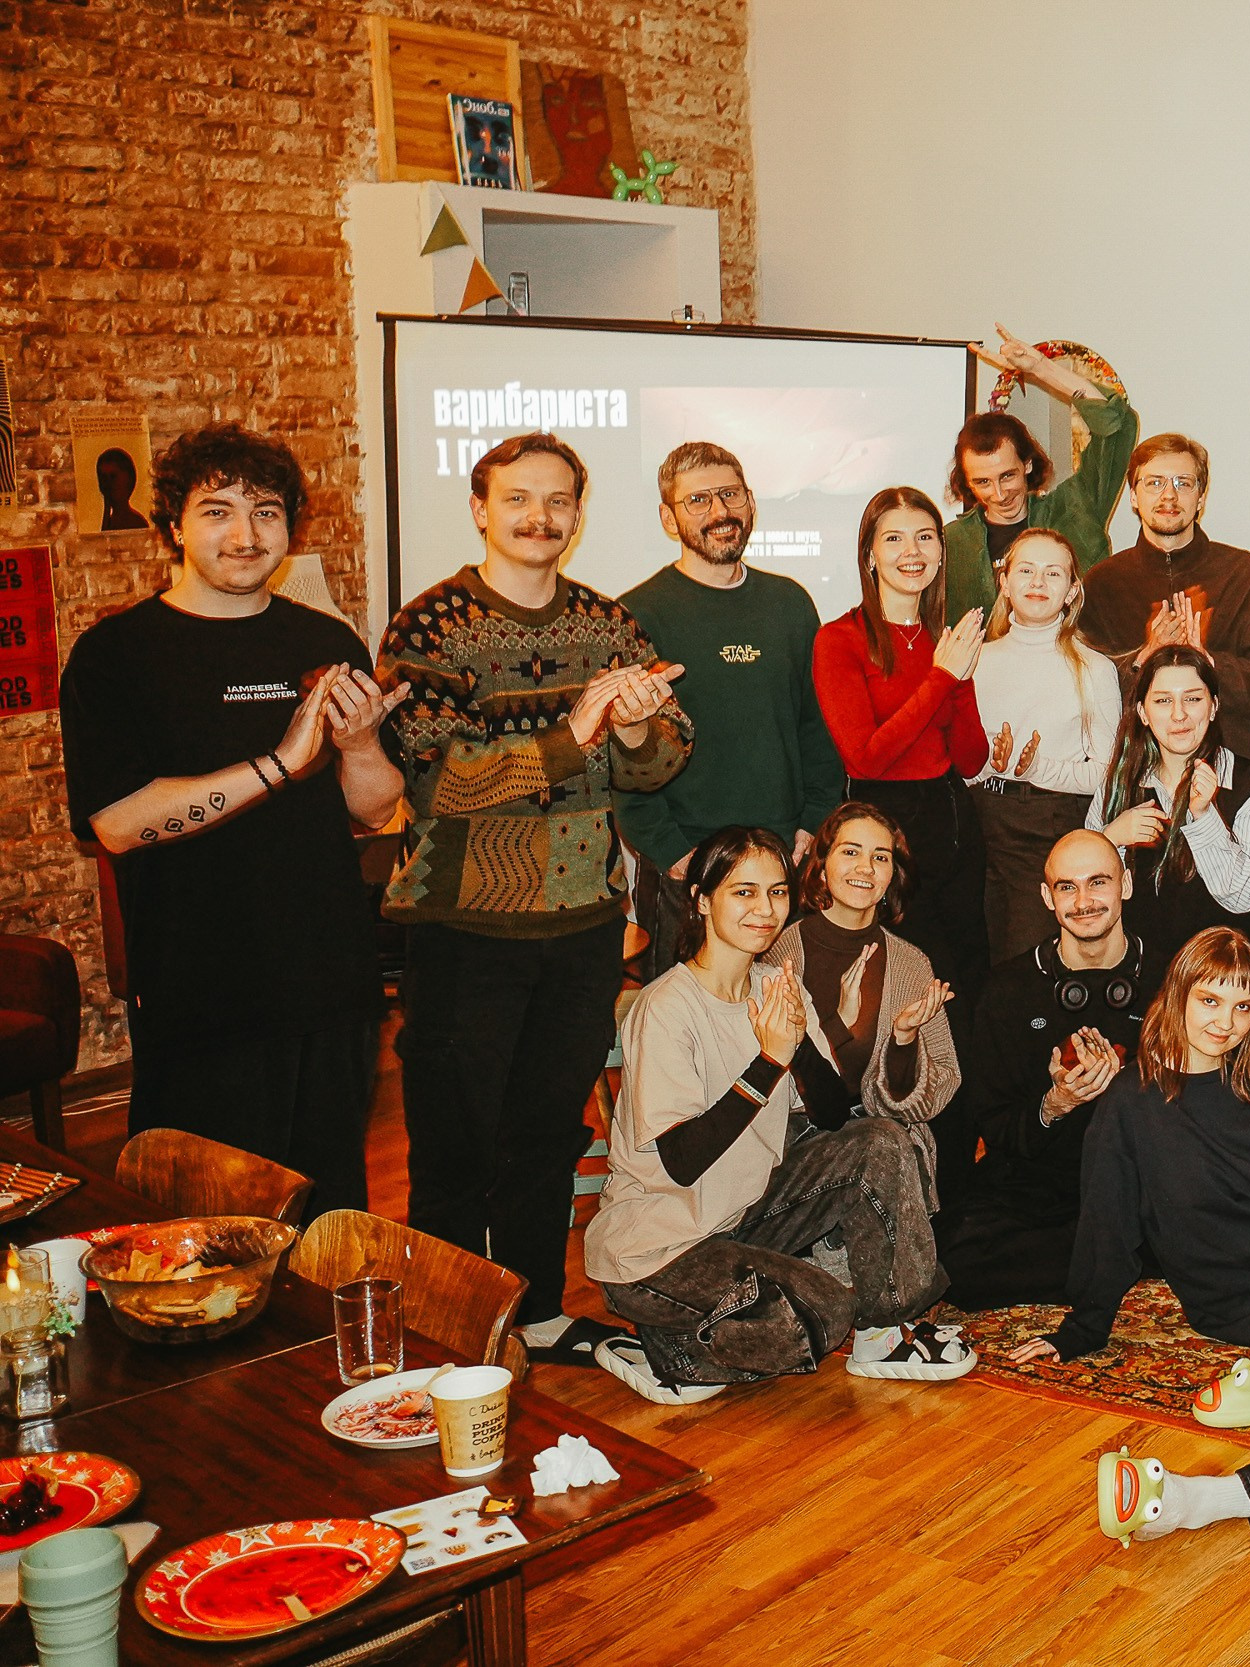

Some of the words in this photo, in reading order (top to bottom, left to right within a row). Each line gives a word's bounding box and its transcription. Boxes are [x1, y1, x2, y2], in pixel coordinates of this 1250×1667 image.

[433, 381, 628, 435] варибариста
[436, 438, 451, 476] 1
[457, 438, 504, 476] го
[719, 644, 760, 655] STAR
[722, 652, 761, 663] WARS
[223, 691, 253, 701] KANGA
[253, 690, 298, 700] ROASTERS
